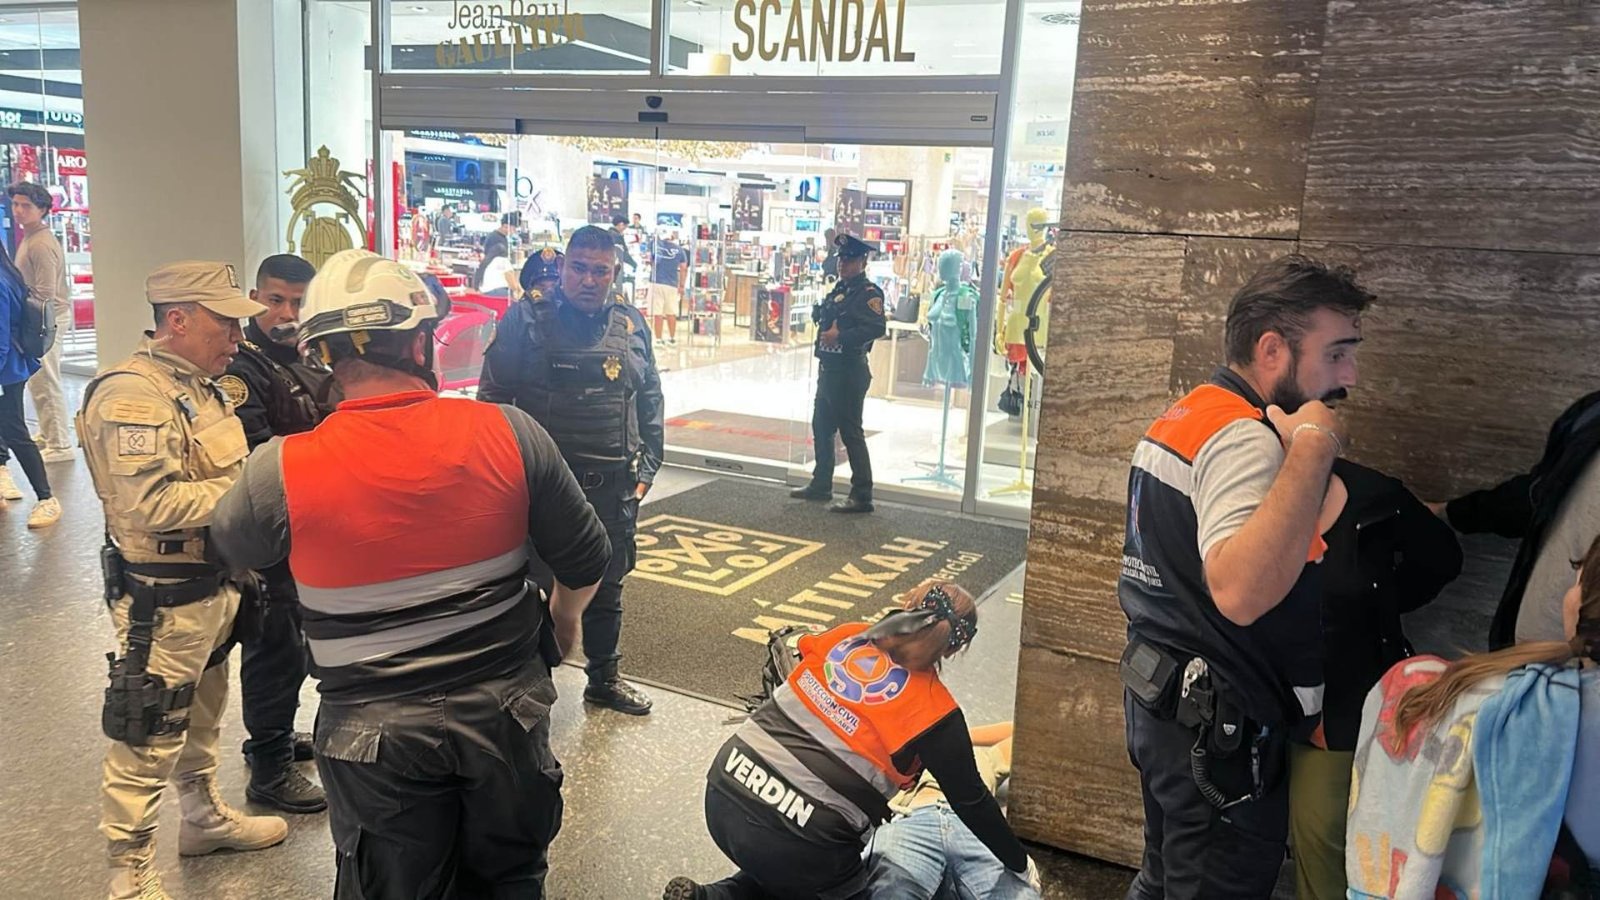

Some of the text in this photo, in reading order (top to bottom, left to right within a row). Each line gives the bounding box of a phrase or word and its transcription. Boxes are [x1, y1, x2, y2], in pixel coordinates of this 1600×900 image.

[435, 12, 587, 67] GAULTIER
[448, 0, 505, 29] Jean
[732, 0, 916, 62] SCANDAL
[838, 706, 859, 728] CIVIL
[725, 747, 815, 828] VERDIN
